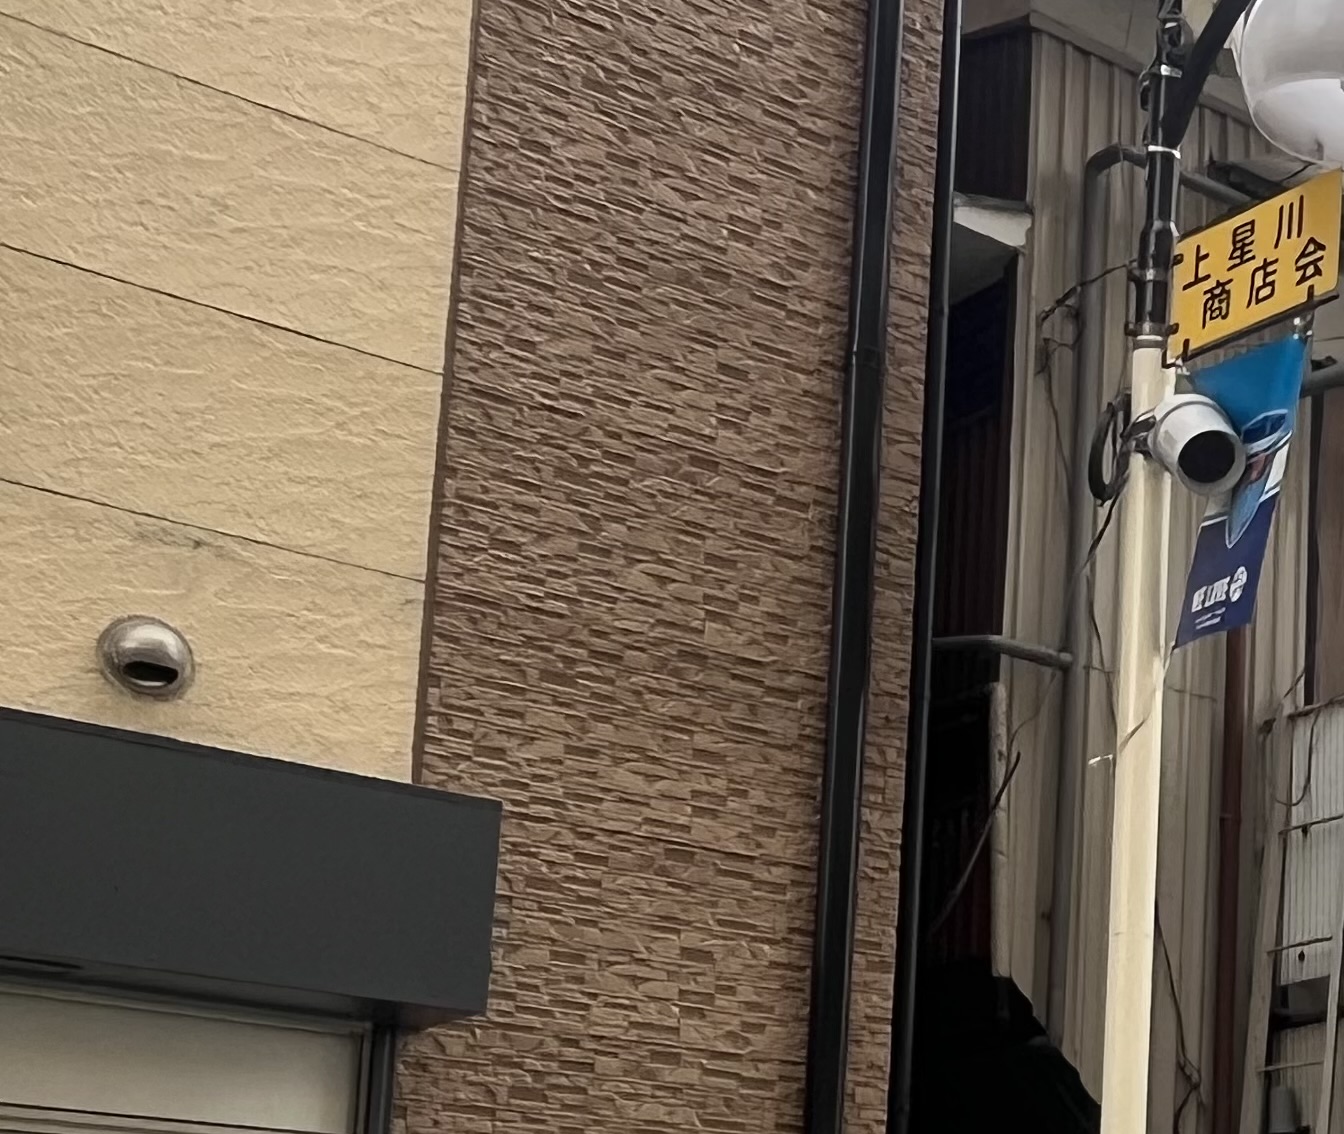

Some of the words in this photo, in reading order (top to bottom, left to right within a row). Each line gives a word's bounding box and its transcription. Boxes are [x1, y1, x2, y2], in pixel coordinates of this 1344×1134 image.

[1182, 194, 1304, 291] 上星川
[1202, 236, 1327, 330] 商店会
